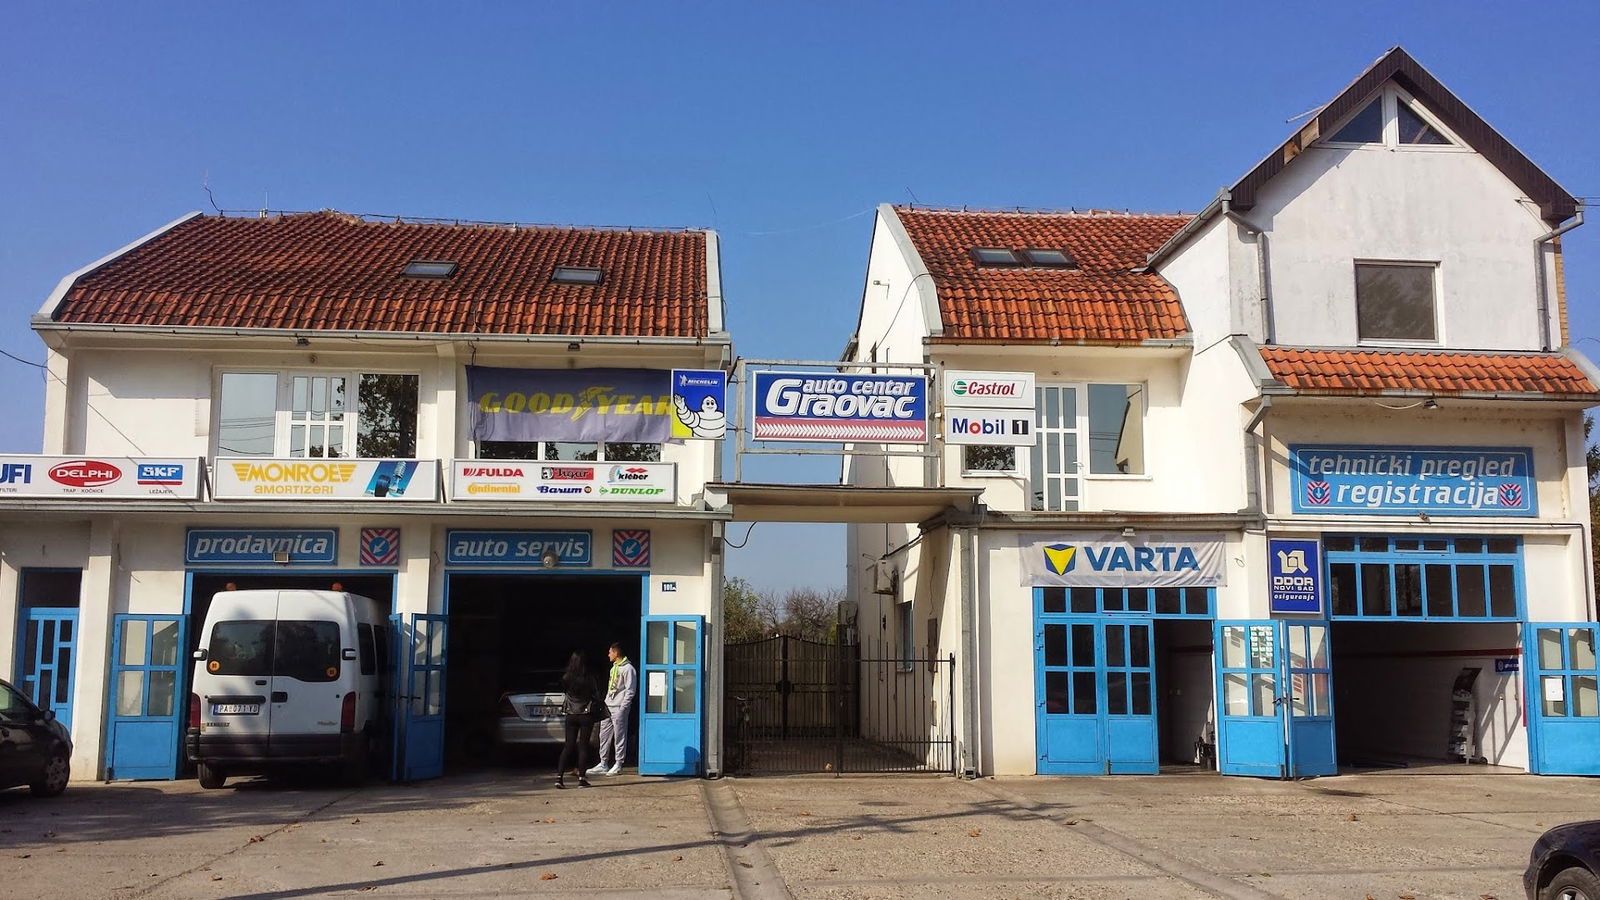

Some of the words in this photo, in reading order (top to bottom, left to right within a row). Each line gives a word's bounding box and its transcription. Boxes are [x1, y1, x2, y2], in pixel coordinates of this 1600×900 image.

[802, 378, 847, 395] auto
[851, 380, 915, 396] centar
[967, 380, 1015, 396] Castrol
[478, 392, 574, 415] GOOD
[766, 378, 918, 419] Graovac
[952, 418, 1005, 435] Mobil
[1015, 420, 1026, 434] 1
[56, 469, 113, 478] DELPHI
[142, 467, 179, 477] SKF
[247, 463, 341, 483] MONROE
[475, 468, 524, 477] FULDA
[1308, 453, 1411, 477] tehnički
[1419, 457, 1515, 481] pregled
[537, 485, 582, 494] Barum
[1337, 481, 1499, 509] registracija
[194, 534, 328, 557] prodavnica
[454, 539, 508, 557] auto
[515, 539, 584, 557] servis
[1084, 546, 1200, 572] VARTA
[1273, 576, 1314, 586] DDOR
[1273, 593, 1315, 602] osiguranje
